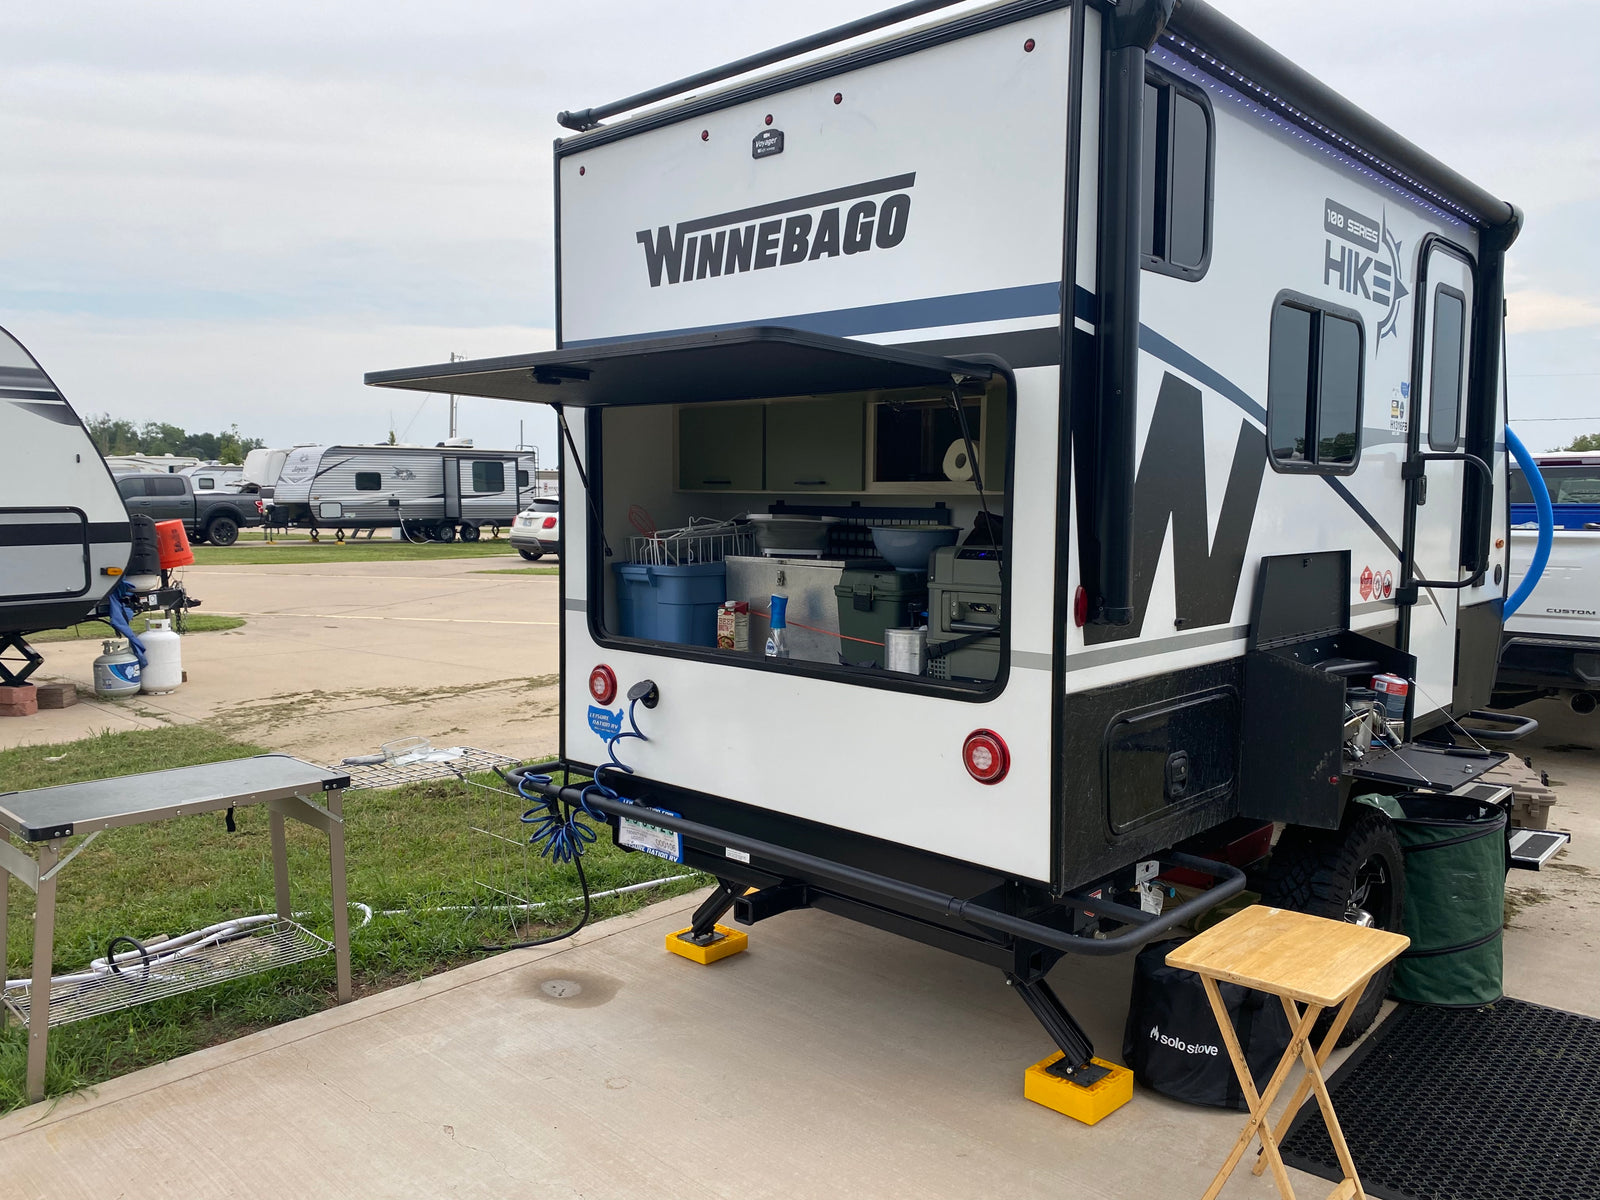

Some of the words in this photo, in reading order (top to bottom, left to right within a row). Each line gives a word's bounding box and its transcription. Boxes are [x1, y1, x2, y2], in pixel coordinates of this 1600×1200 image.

[636, 171, 916, 287] WINNEBAGO
[1327, 209, 1344, 228] 100
[1347, 218, 1378, 243] SERIES
[1324, 238, 1392, 307] HIKE
[1160, 1034, 1186, 1051] solo
[1186, 1044, 1219, 1056] stove
